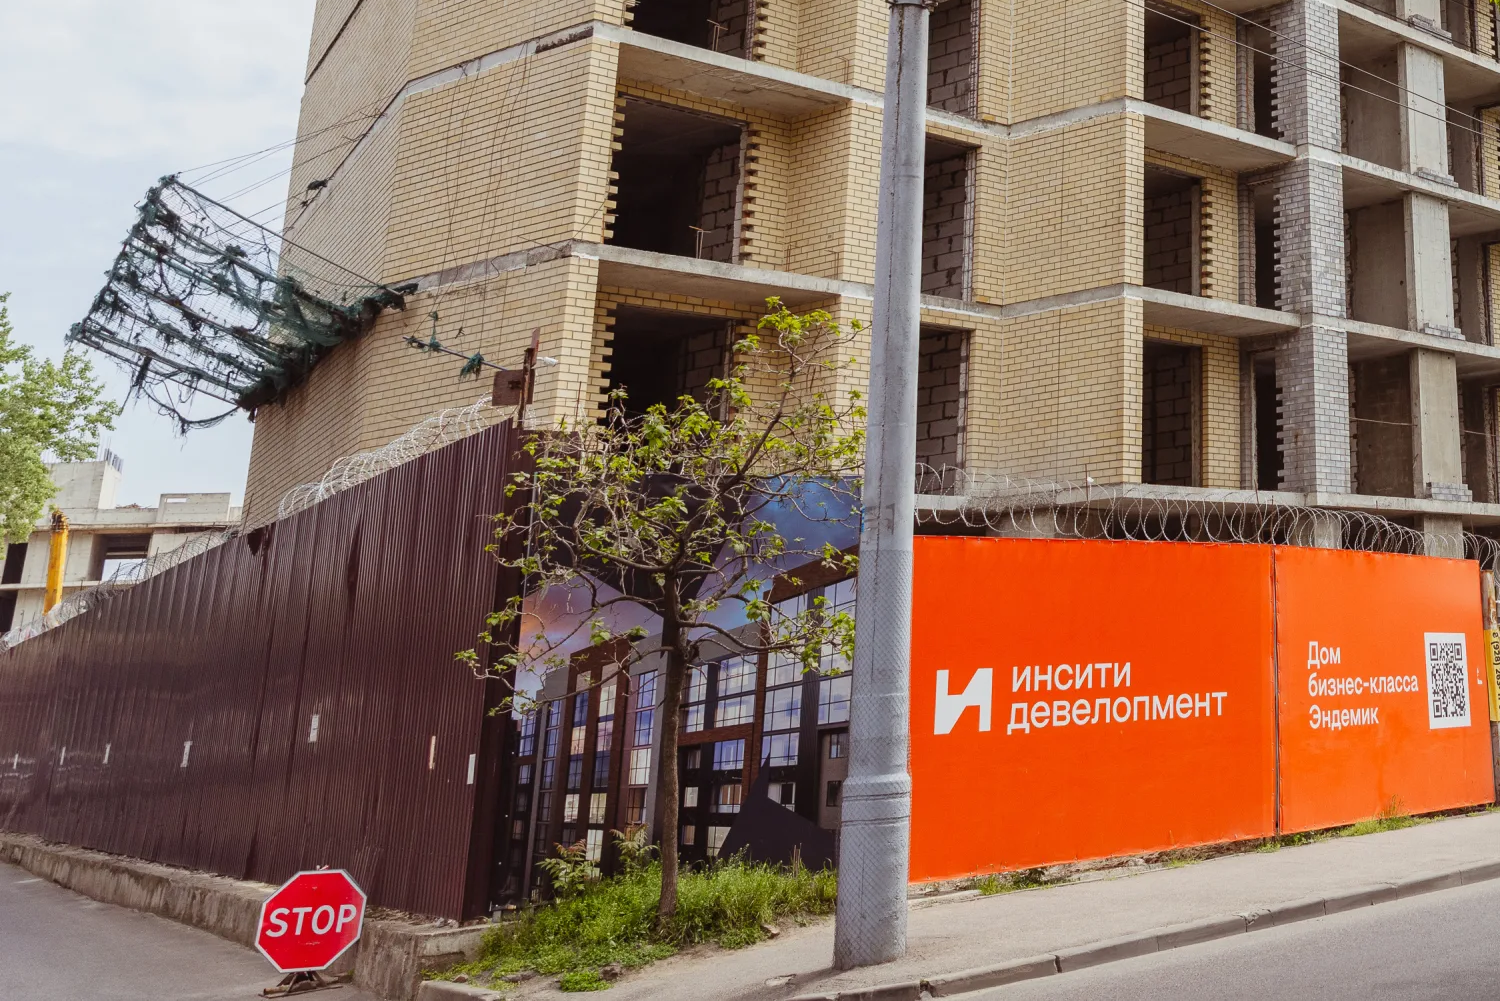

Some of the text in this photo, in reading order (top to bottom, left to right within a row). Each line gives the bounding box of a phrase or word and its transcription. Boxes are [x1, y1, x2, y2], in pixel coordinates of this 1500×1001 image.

[1307, 641, 1341, 670] Дом
[1308, 672, 1419, 697] бизнес-класса
[1007, 691, 1228, 735] девелопмент
[1309, 704, 1380, 731] Эндемик
[265, 904, 357, 938] STOP
